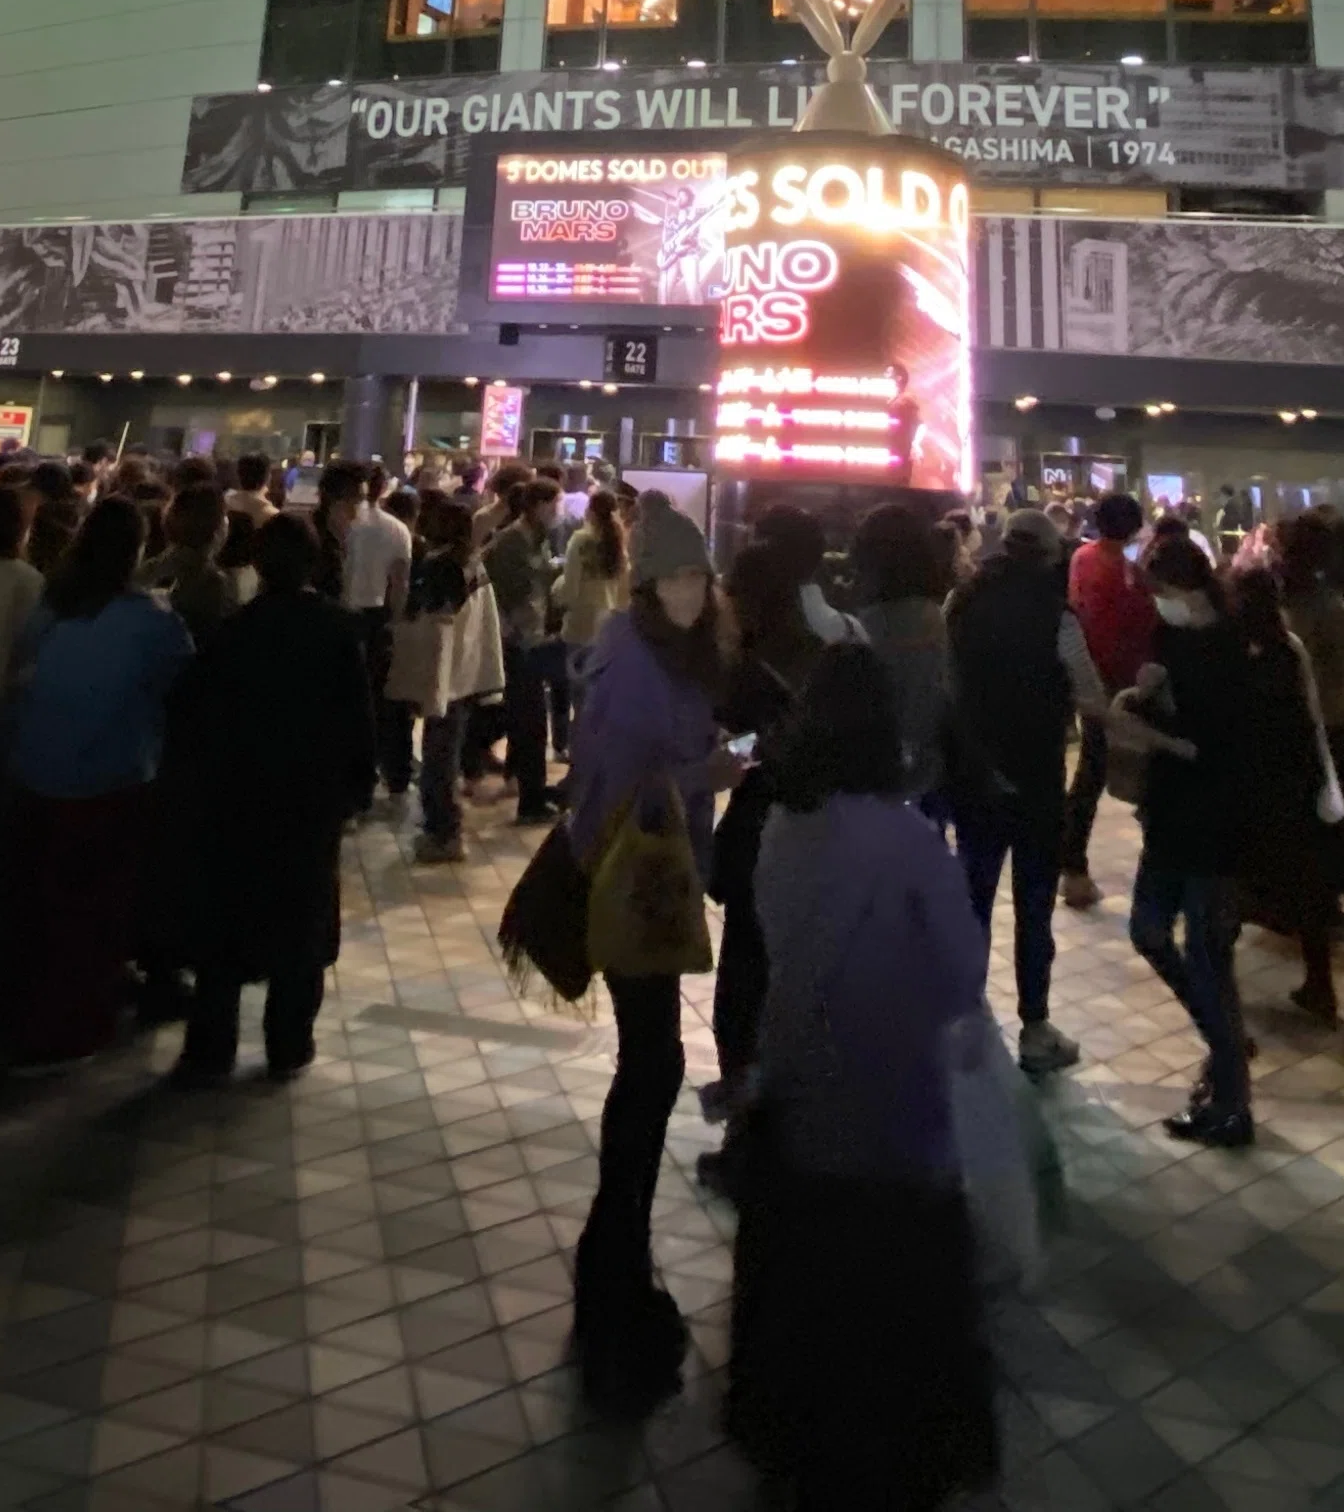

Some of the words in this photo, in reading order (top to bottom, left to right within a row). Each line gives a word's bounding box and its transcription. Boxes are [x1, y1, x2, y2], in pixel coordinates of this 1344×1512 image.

[462, 90, 621, 133] GIANTS
[637, 87, 752, 131] WILL
[1107, 140, 1176, 166] 1974
[525, 160, 604, 182] DOMES
[607, 159, 667, 181] SOLD
[671, 158, 726, 180] OUT
[770, 164, 941, 230] SOLD
[511, 199, 629, 221] BRUNO
[520, 220, 617, 241] MARS
[0, 337, 21, 356] 23
[624, 340, 647, 363] 22
